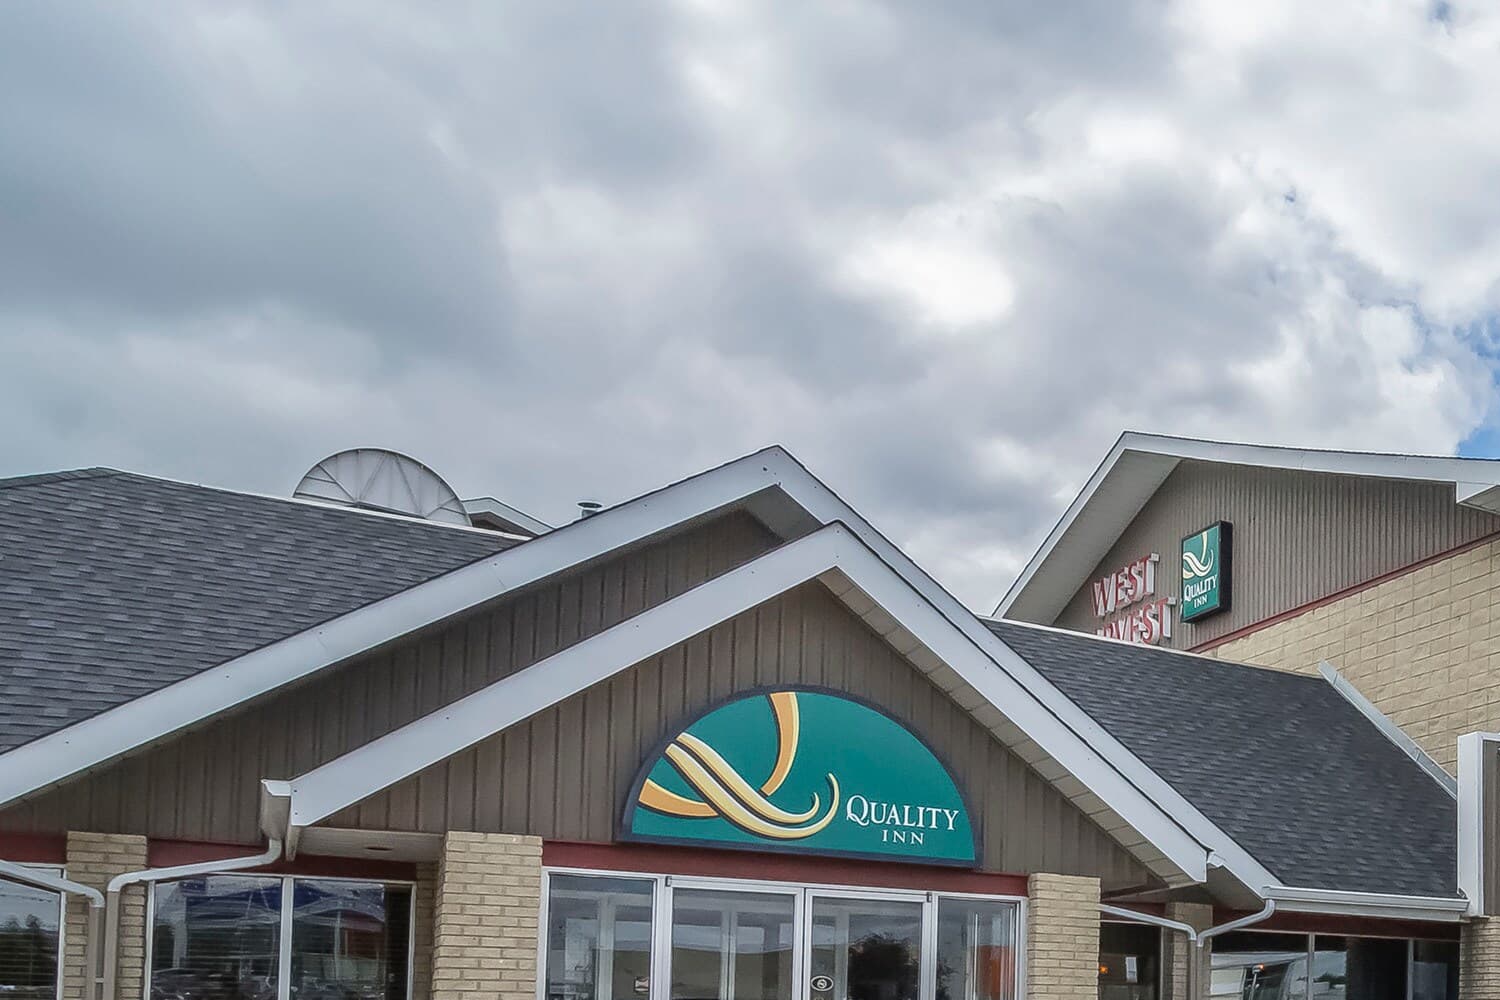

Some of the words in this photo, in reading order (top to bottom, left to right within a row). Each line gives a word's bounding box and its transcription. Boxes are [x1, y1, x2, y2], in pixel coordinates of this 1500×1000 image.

[1091, 553, 1160, 616] WEST
[1184, 574, 1217, 601] QUALITY
[1193, 595, 1208, 609] INN
[846, 795, 959, 831] QUALITY
[881, 829, 924, 845] INN
